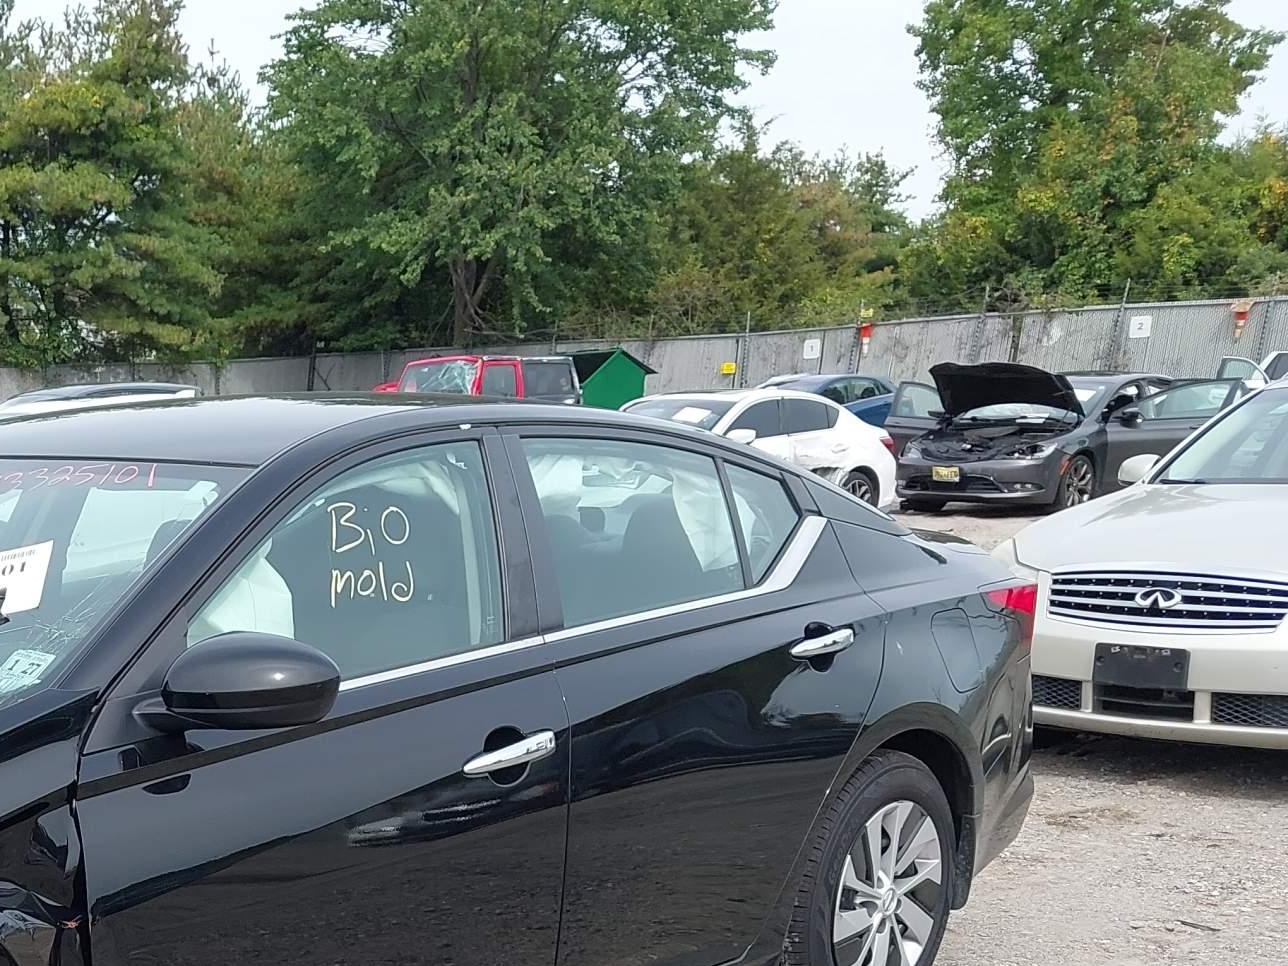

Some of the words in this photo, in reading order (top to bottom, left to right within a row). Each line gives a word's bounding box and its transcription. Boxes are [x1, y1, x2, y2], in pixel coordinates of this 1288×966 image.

[1137, 322, 1144, 330] 2
[7, 659, 21, 671] 1
[20, 662, 43, 676] 27
